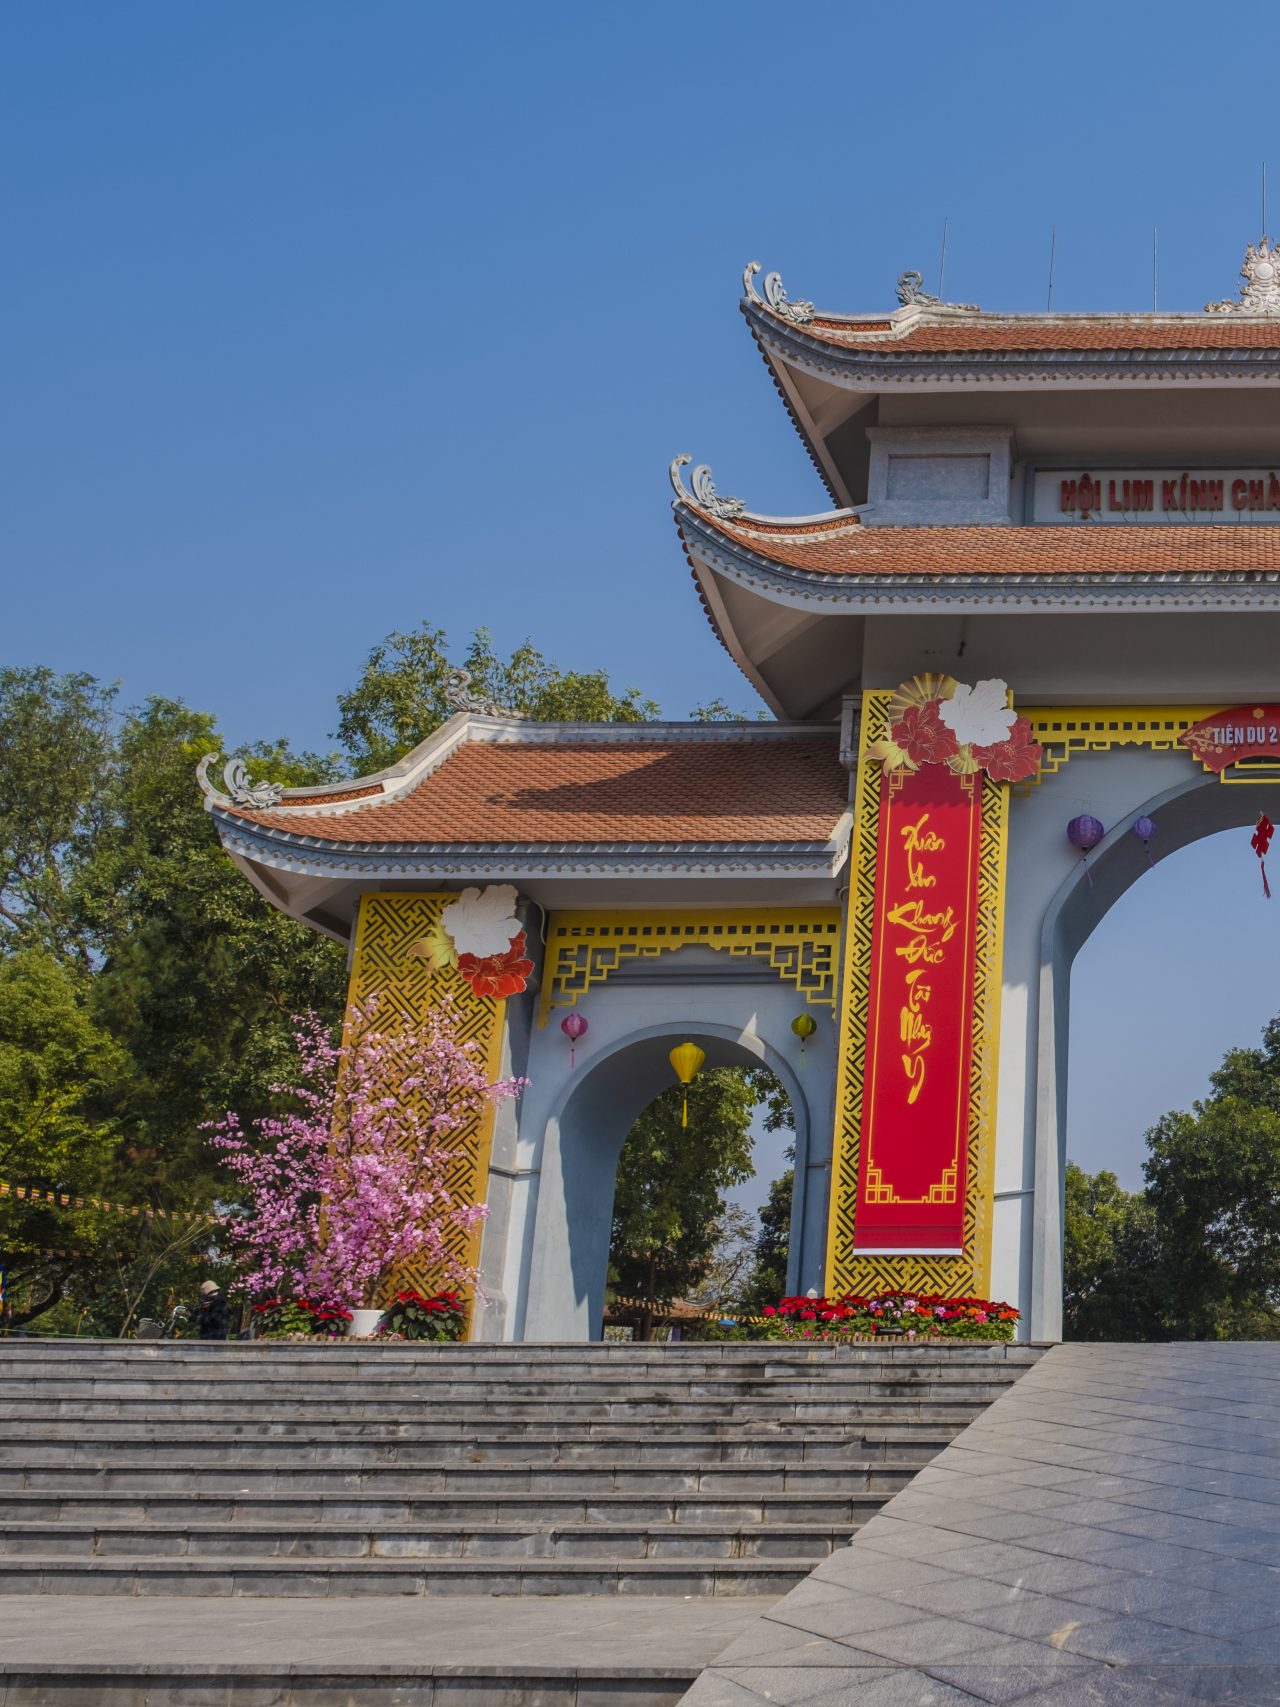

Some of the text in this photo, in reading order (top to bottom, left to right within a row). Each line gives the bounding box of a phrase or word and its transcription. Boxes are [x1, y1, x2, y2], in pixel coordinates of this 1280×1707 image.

[1061, 473, 1101, 519] HỘI
[1109, 480, 1153, 511] LIM
[1162, 472, 1223, 511] KÍNH
[1212, 724, 1244, 744] TIÊN
[1247, 727, 1265, 744] DU
[901, 813, 946, 857] Xuân
[887, 900, 962, 942] Khang
[896, 934, 946, 964] Đức
